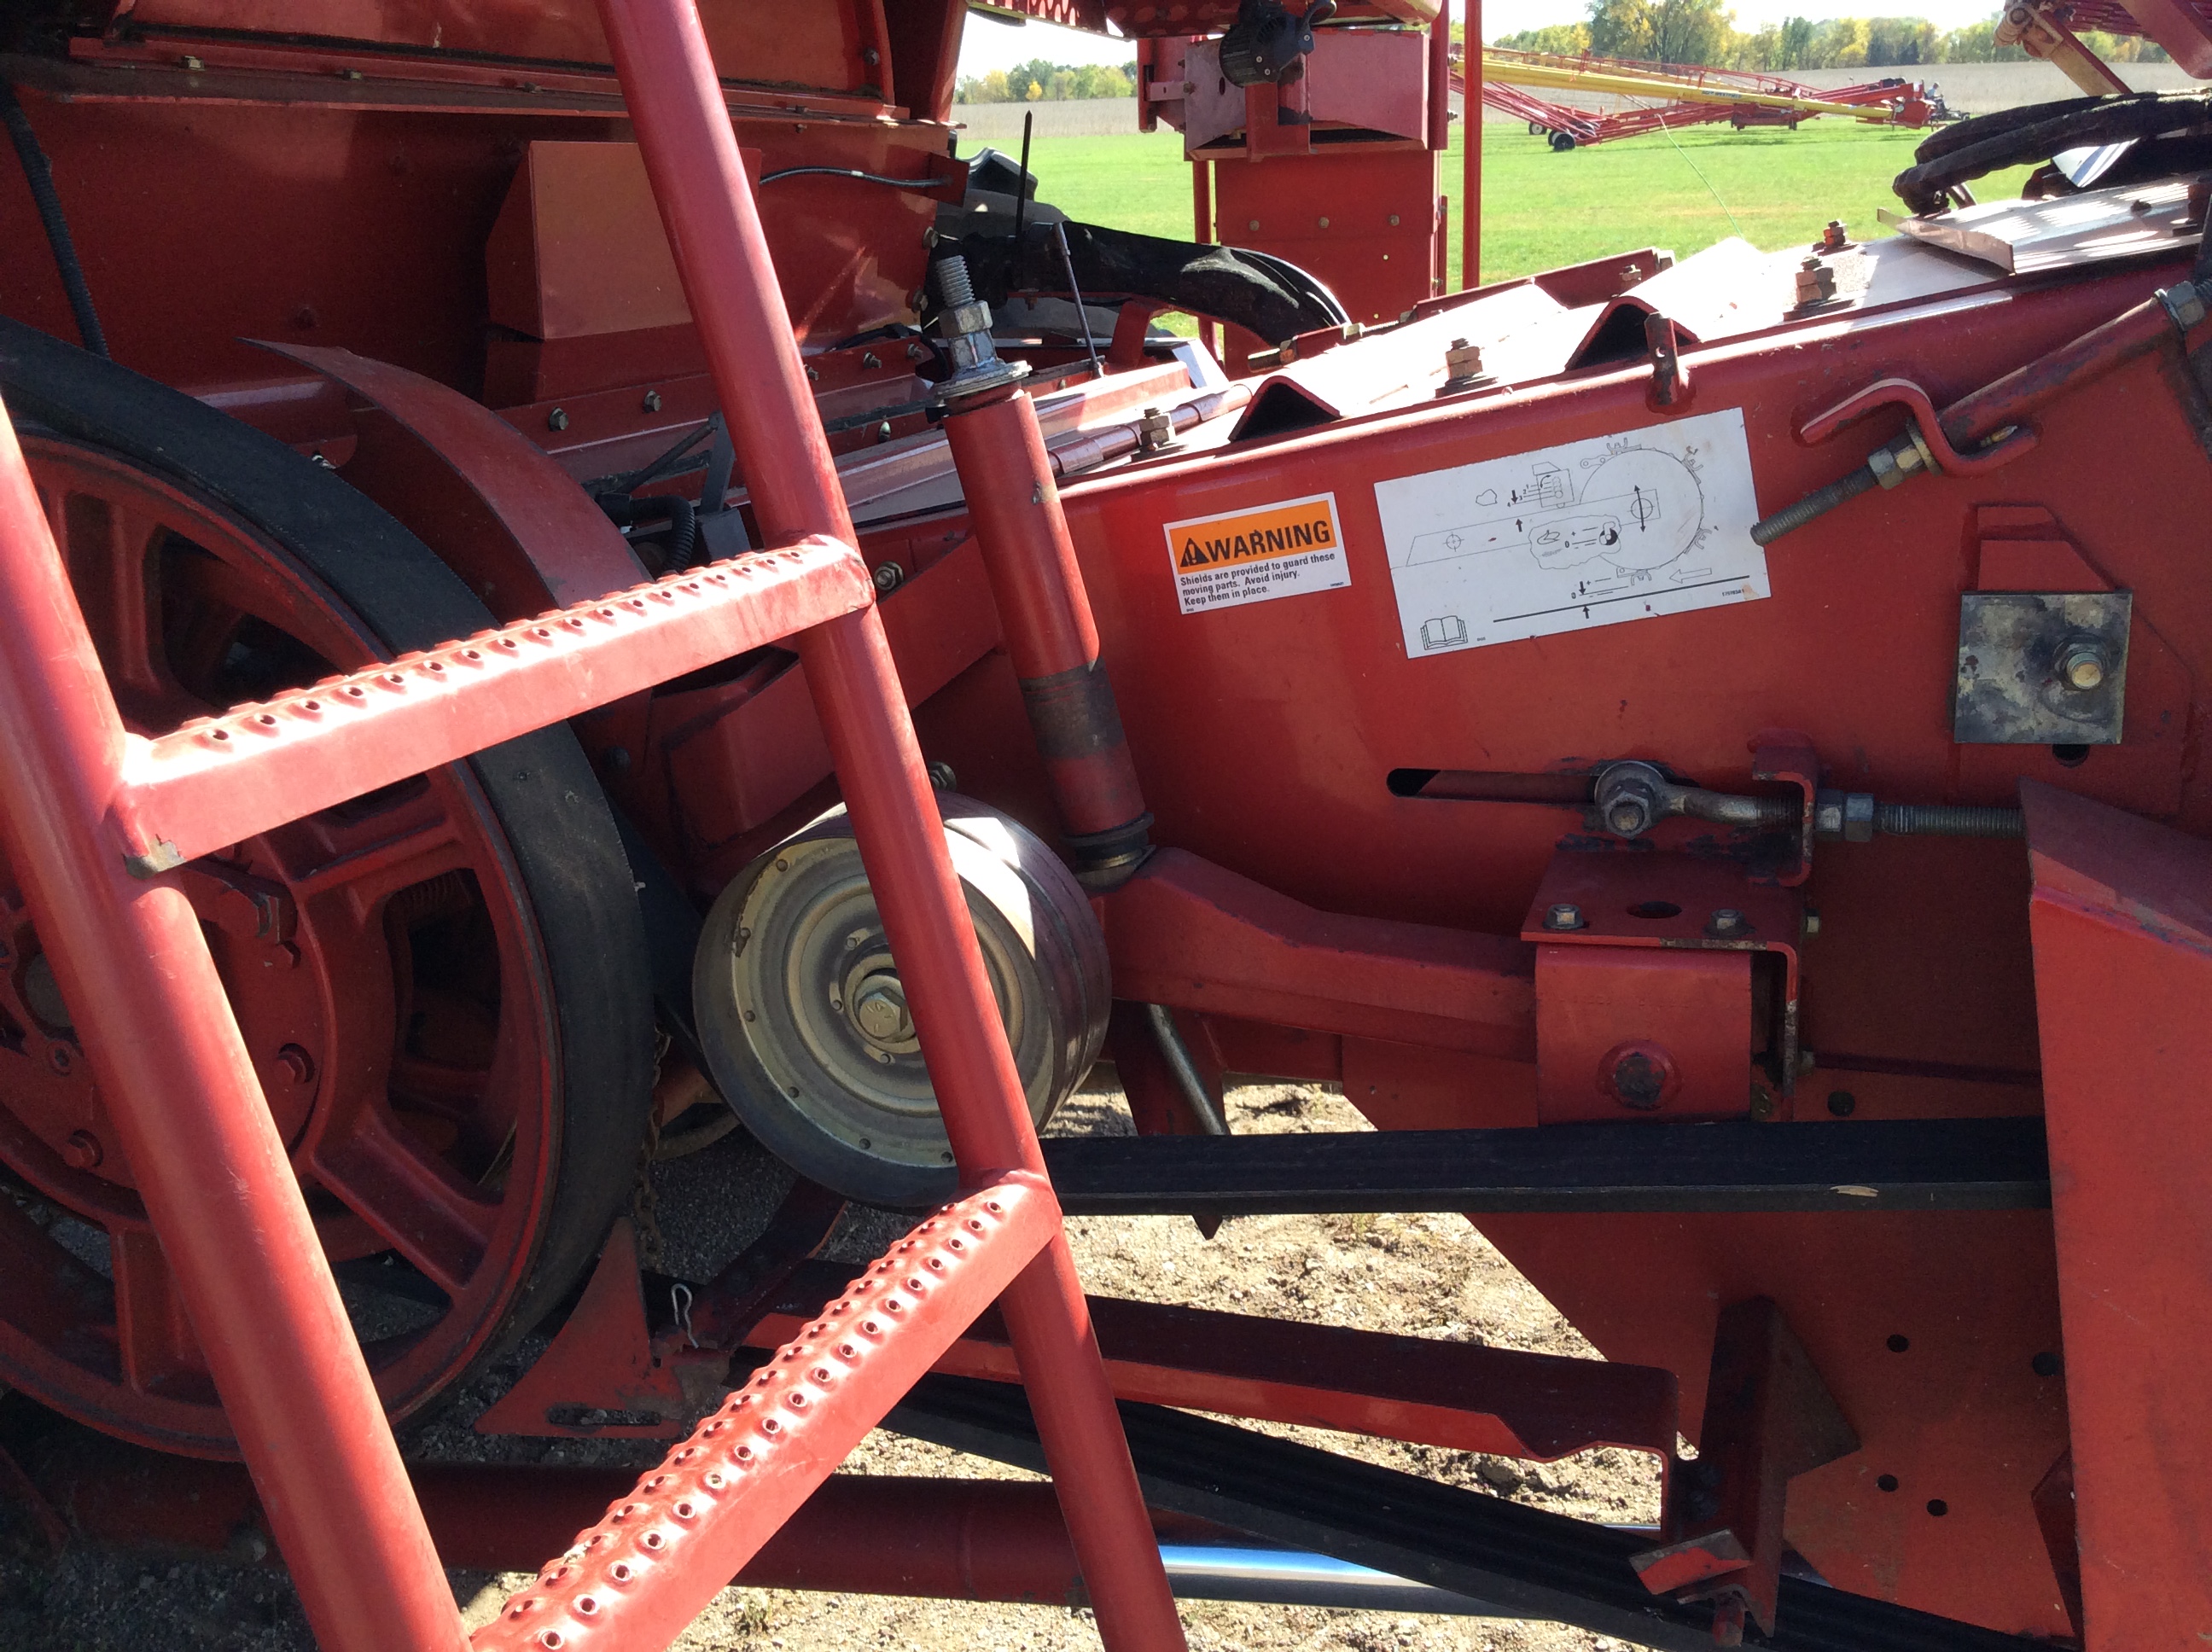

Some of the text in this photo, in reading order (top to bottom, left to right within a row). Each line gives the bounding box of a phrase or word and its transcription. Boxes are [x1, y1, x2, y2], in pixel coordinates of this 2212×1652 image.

[1205, 520, 1330, 562] WARNING
[1180, 553, 1336, 586] Shields are provided to guard these
[1183, 570, 1300, 596] moving parts. Avoid injury.
[1184, 585, 1270, 607] Keep them in place.
